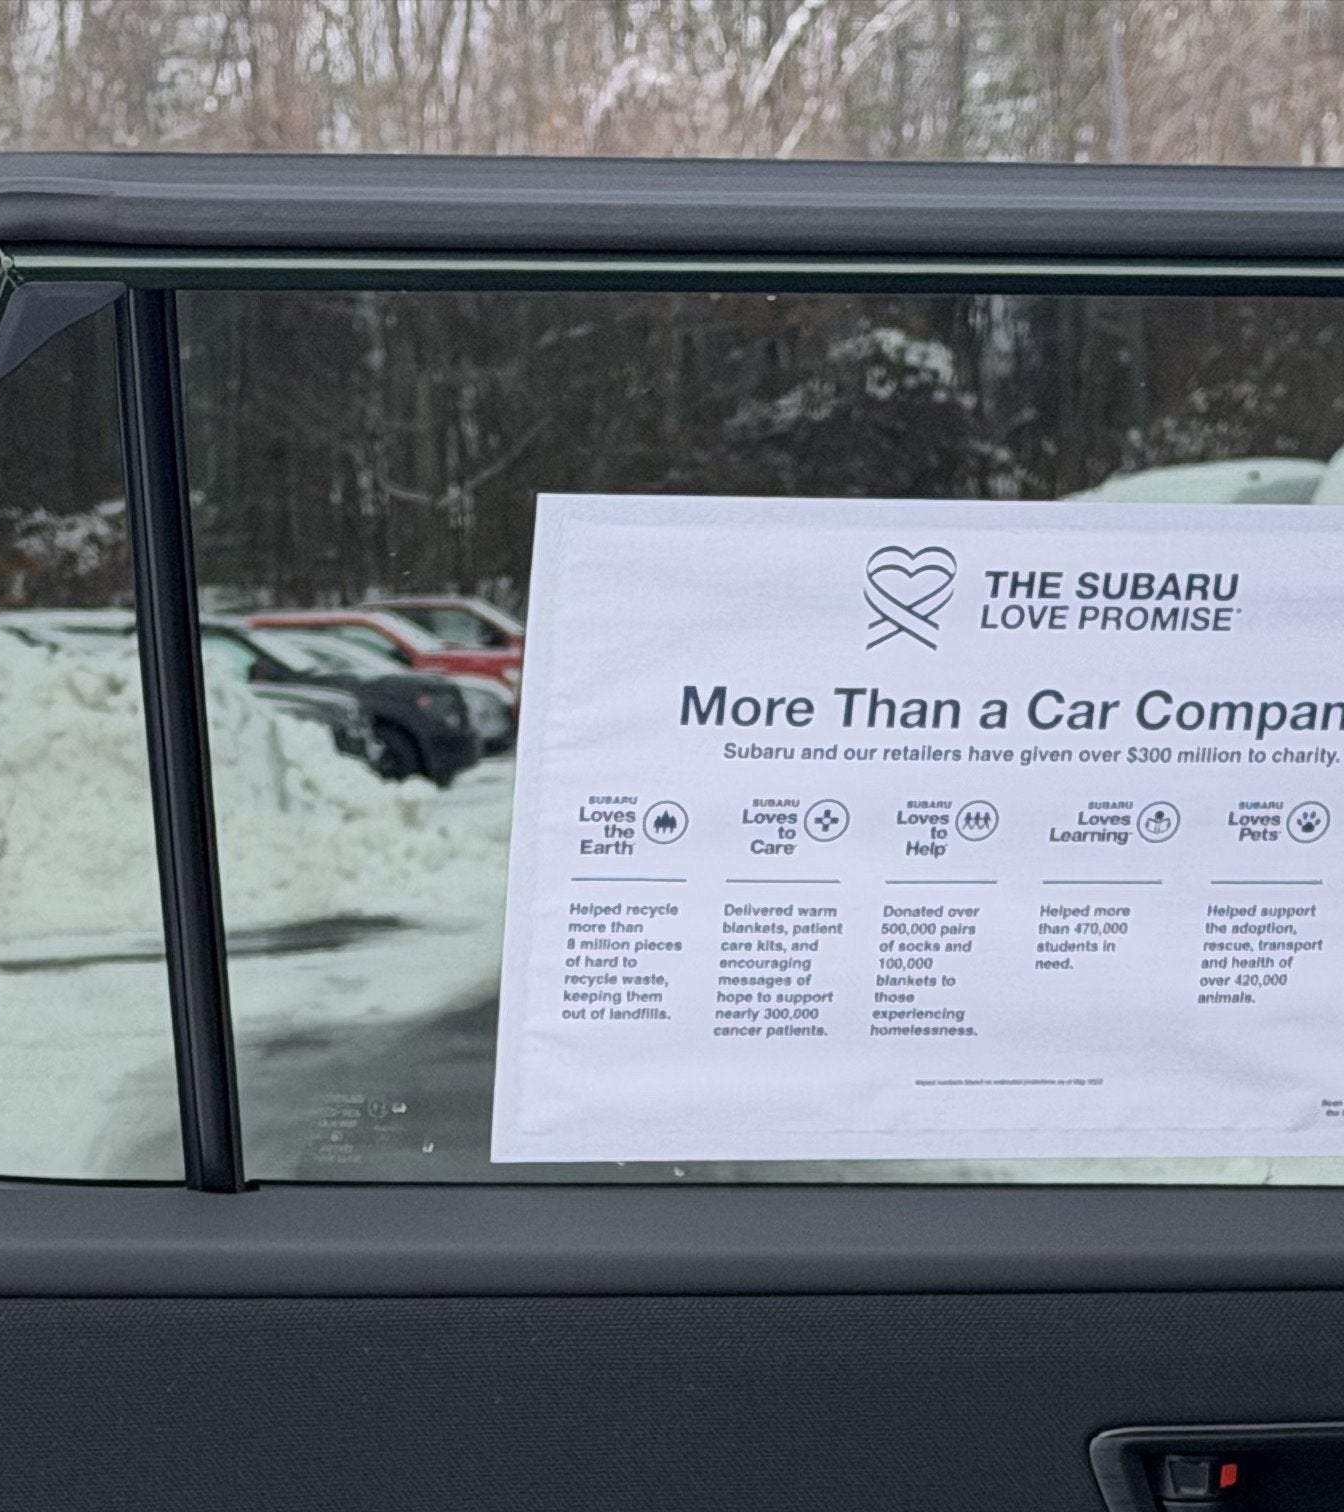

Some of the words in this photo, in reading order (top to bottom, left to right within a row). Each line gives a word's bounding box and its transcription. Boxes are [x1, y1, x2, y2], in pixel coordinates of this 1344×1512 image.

[985, 571, 1063, 599] THE
[1076, 572, 1238, 601] SUBARU
[981, 604, 1069, 629] LOVE
[1079, 606, 1233, 631] PROMISE
[681, 686, 814, 727] More
[834, 688, 960, 728] Than
[980, 700, 1007, 729] a
[1028, 690, 1120, 730] Car
[724, 742, 795, 759] Subaru
[801, 744, 838, 760] and
[843, 747, 876, 764] our
[883, 745, 961, 761] retailers
[968, 746, 1014, 762] have
[1020, 746, 1072, 766] given
[1079, 750, 1121, 762] over
[1127, 747, 1172, 764] $300
[1177, 747, 1241, 763] million
[1247, 747, 1267, 766] to
[1272, 747, 1339, 767] charity.
[589, 796, 637, 805] SUBARU
[753, 799, 800, 808] SUBARU
[907, 801, 952, 809] SUBARU
[1088, 801, 1133, 810] SUBARU
[1239, 801, 1283, 809] SUBARU
[579, 806, 636, 823] Loves
[743, 809, 798, 824] Loves
[897, 811, 949, 825] Loves
[1078, 811, 1131, 826] Loves
[1228, 811, 1280, 826] Loves
[604, 824, 635, 838] the
[778, 826, 796, 839] to
[931, 826, 948, 839] to
[570, 903, 622, 918] Helped
[626, 903, 678, 918] recycle
[724, 904, 793, 916] Delivered
[798, 908, 837, 917] warm
[883, 905, 944, 917] Donated
[948, 908, 980, 917] over
[1040, 905, 1090, 920] Helped
[1094, 907, 1130, 917] more
[1208, 905, 1257, 919] Helped
[1261, 905, 1316, 919] support
[568, 923, 606, 933] more
[611, 921, 643, 933] than
[723, 922, 788, 936] blankets,
[792, 923, 843, 937] patient
[881, 923, 936, 936] 500,000
[940, 923, 976, 938] pairs
[1039, 923, 1070, 934] than
[1074, 922, 1128, 936] 470,000
[1206, 922, 1227, 934] the
[1232, 922, 1297, 936] adoption,
[567, 938, 575, 949] 8
[580, 938, 630, 950] million
[634, 939, 682, 953] pieces
[721, 942, 752, 951] care
[757, 940, 787, 953] kits,
[791, 939, 819, 951] and
[879, 940, 894, 952] of
[898, 940, 940, 952] socks
[945, 940, 972, 952] and
[1037, 940, 1098, 952] students
[1103, 940, 1116, 952] in
[1203, 942, 1254, 952] rescue,
[1258, 939, 1323, 953] transport
[565, 955, 581, 967] of
[585, 956, 619, 968] hard
[623, 957, 637, 968] to
[720, 957, 811, 972] encouraging
[879, 957, 933, 971] 100,000
[1035, 958, 1073, 969] need.
[1201, 957, 1227, 969] and
[1232, 956, 1274, 968] health
[1279, 956, 1293, 968] of
[565, 973, 617, 988] recycle
[622, 974, 668, 987] waste,
[719, 976, 792, 989] messages
[796, 974, 812, 986] of
[876, 974, 936, 986] blankets
[942, 975, 956, 987] to
[1200, 977, 1231, 986] over
[1234, 974, 1287, 988] 420,000
[564, 990, 621, 1005] keeping
[627, 990, 662, 1002] them
[717, 991, 753, 1005] hope
[757, 992, 771, 1003] to
[776, 992, 833, 1006] support
[875, 992, 914, 1003] those
[1198, 991, 1255, 1003] animals.
[562, 1008, 586, 1019] out
[590, 1007, 605, 1020] of
[610, 1008, 671, 1020] landfills.
[716, 1008, 760, 1022] nearly
[764, 1008, 819, 1020] 300,000
[872, 1008, 965, 1022] experiencing
[713, 1026, 762, 1036] cancer
[766, 1025, 828, 1039] patients.
[870, 1024, 977, 1036] homelessness.
